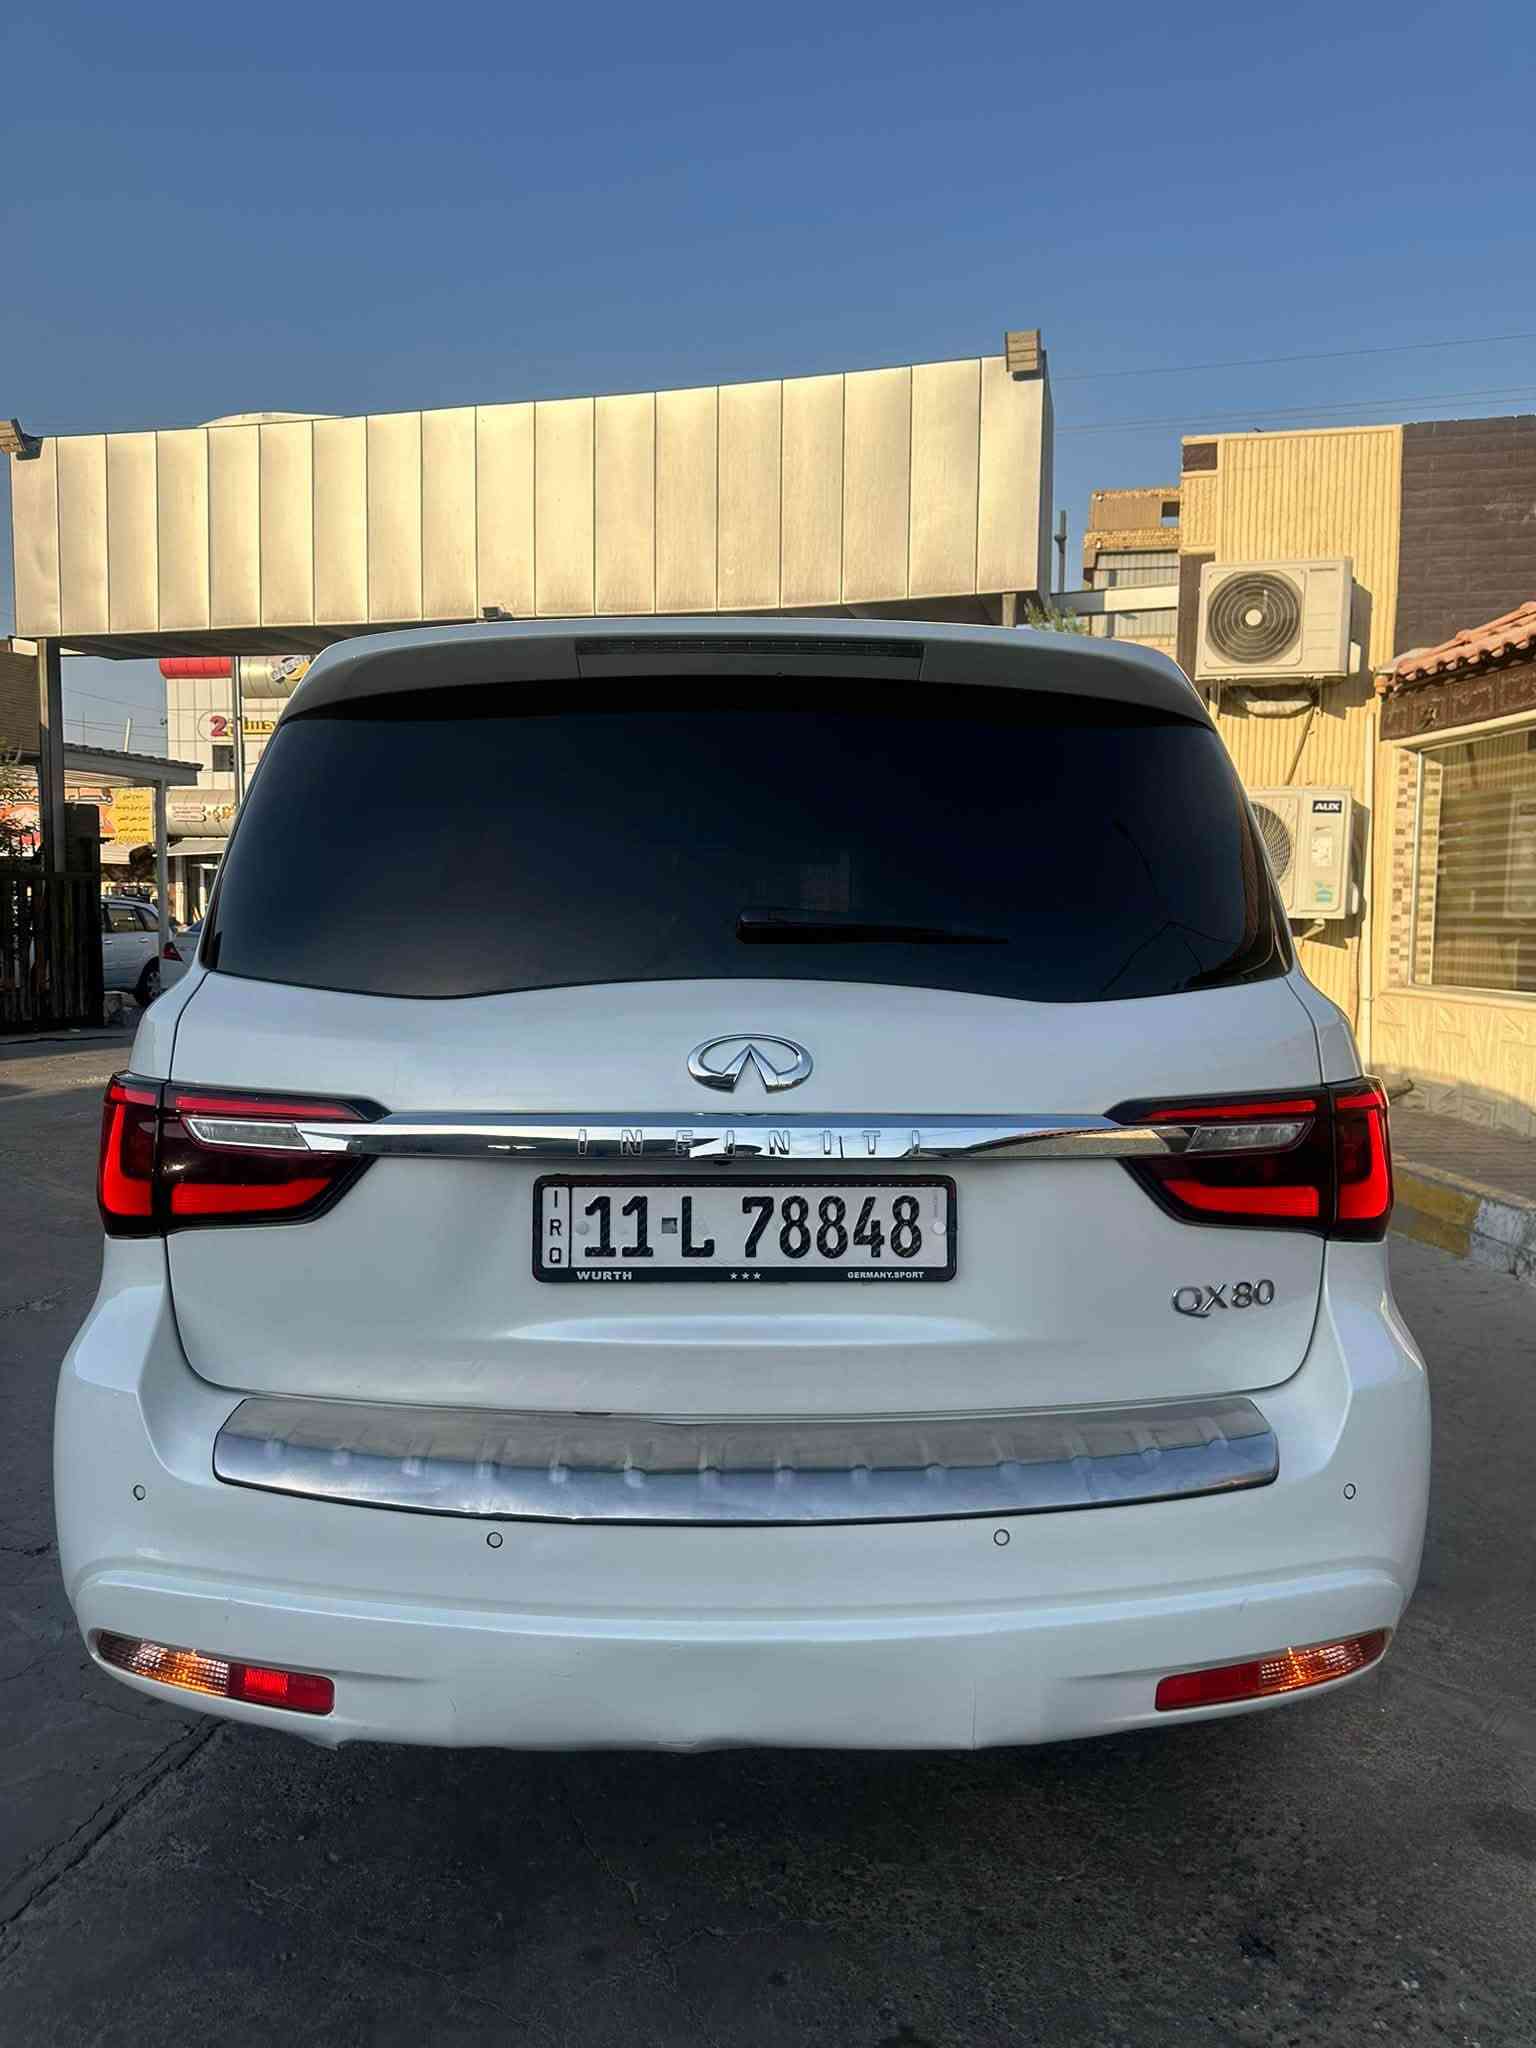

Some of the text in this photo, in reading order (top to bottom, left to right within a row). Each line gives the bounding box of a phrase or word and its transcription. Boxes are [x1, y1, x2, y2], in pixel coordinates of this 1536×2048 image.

[210, 715, 227, 736] 2
[1314, 802, 1340, 811] AUX
[578, 1129, 921, 1156] INFINITI
[742, 1195, 922, 1259] 78848
[576, 1271, 632, 1281] WURTH
[1172, 1279, 1275, 1318] QX80
